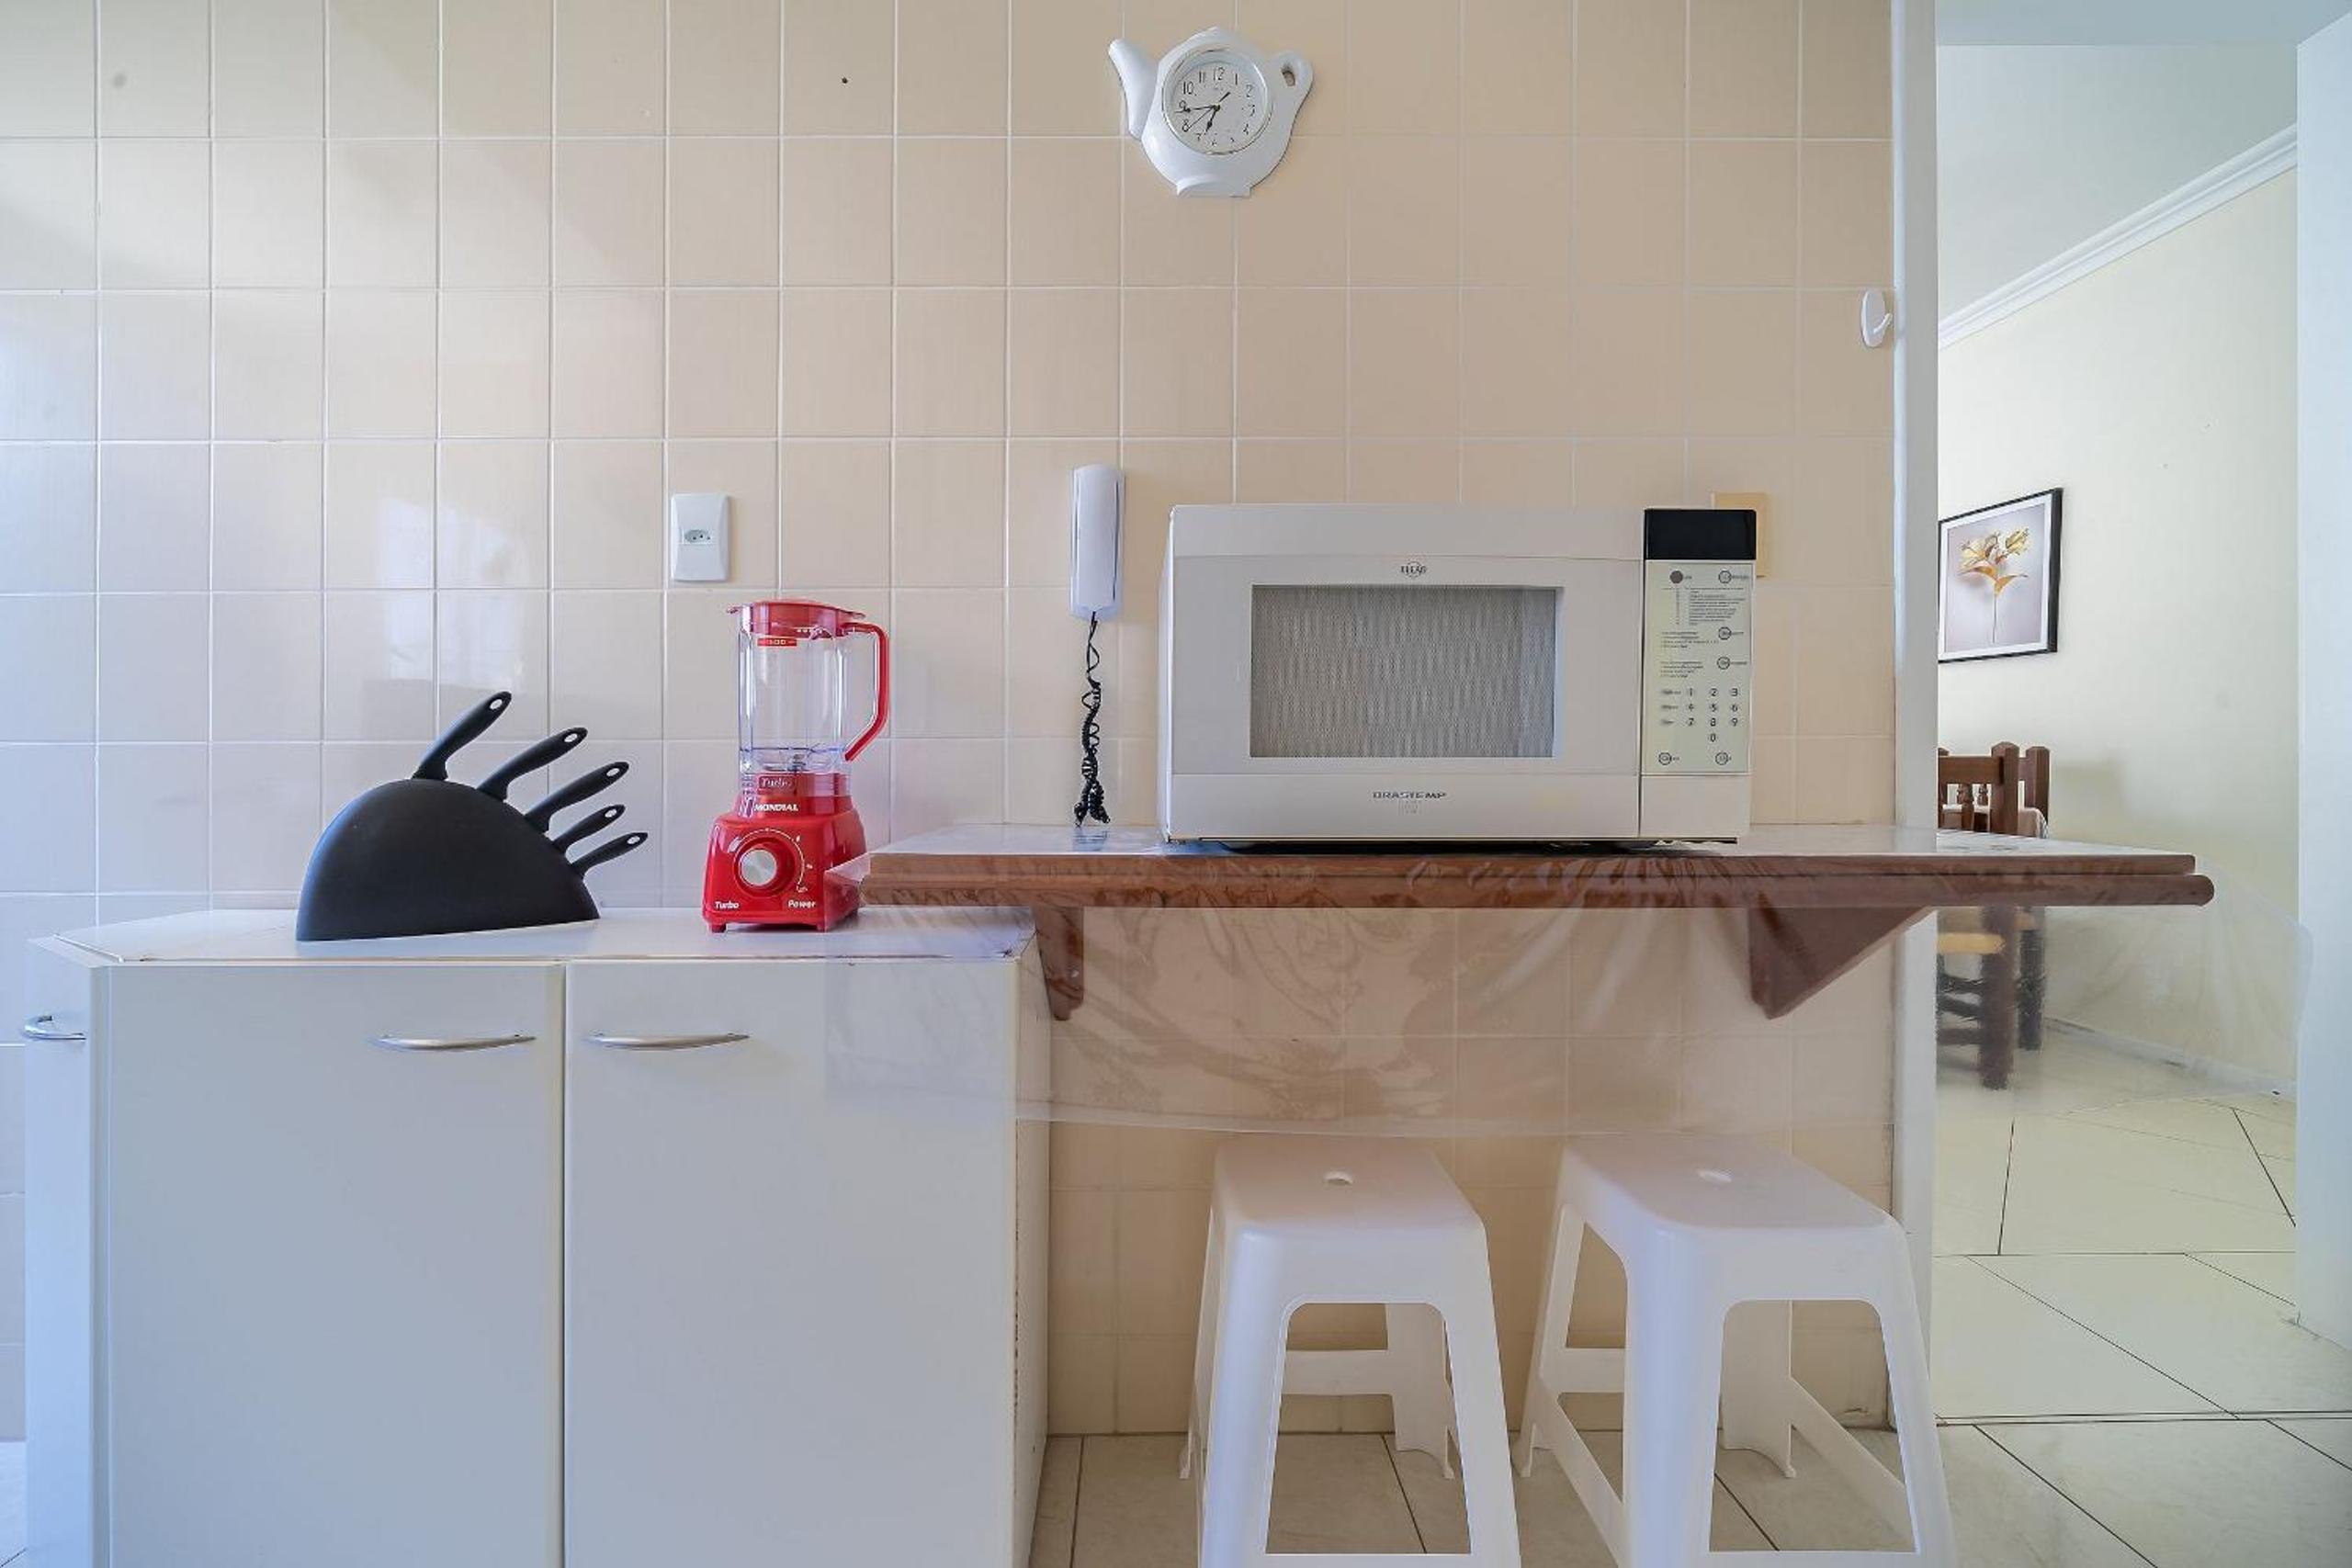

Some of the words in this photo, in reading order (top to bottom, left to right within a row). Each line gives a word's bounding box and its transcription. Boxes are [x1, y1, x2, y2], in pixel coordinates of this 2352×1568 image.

[1199, 71, 1205, 84] 11
[1214, 67, 1226, 81] 12
[1182, 81, 1193, 96] 10
[1246, 84, 1254, 98] 2
[1182, 118, 1190, 133] 8
[1710, 688, 1717, 696] 2
[1730, 688, 1738, 696] 3
[1688, 704, 1695, 712] 4
[1710, 704, 1717, 712] 5
[1731, 704, 1738, 712] 6
[1710, 718, 1716, 727] 8
[1731, 718, 1738, 727] 9
[1710, 734, 1716, 742] 0
[754, 804, 798, 812] MONDIAL
[715, 901, 740, 909] Turbo
[788, 899, 816, 908] Power
